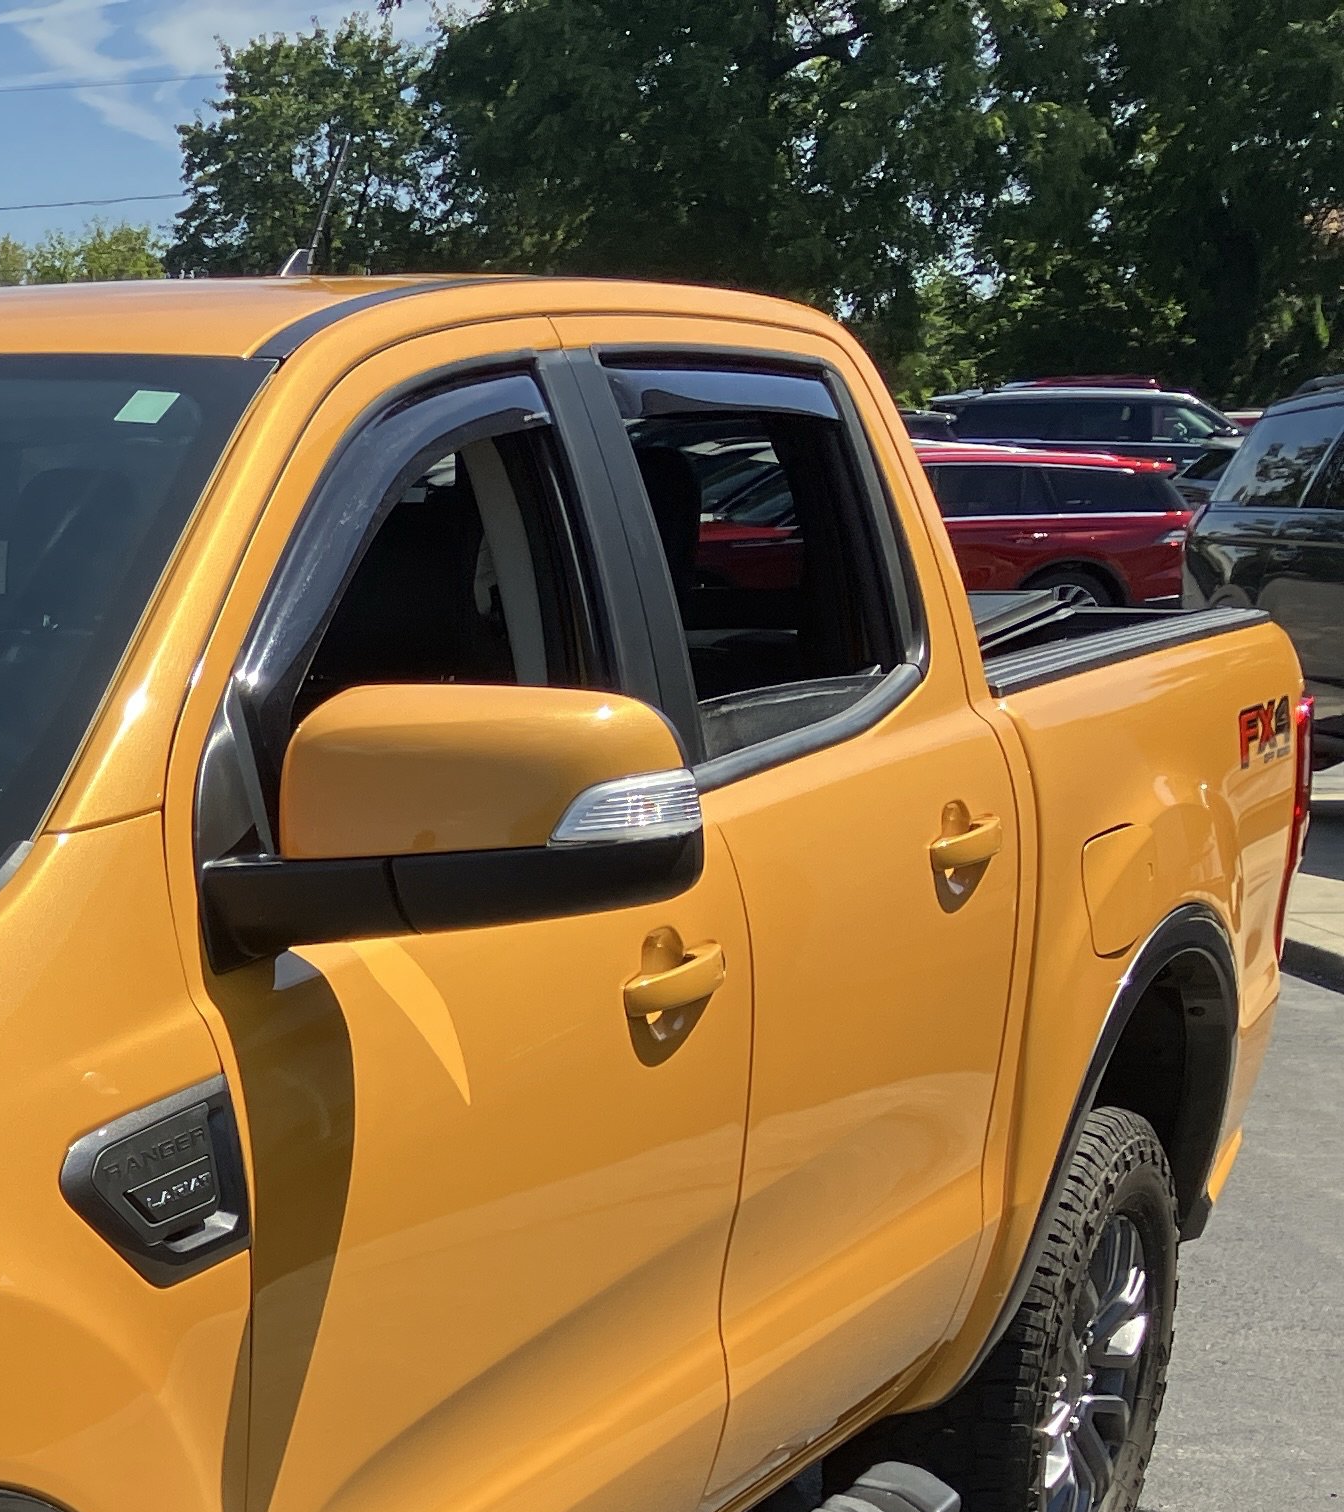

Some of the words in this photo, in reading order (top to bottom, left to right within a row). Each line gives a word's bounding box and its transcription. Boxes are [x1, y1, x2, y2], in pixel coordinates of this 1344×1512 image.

[1238, 694, 1291, 770] FX4
[102, 1125, 205, 1182] RANGER
[145, 1170, 213, 1209] LARIAT
